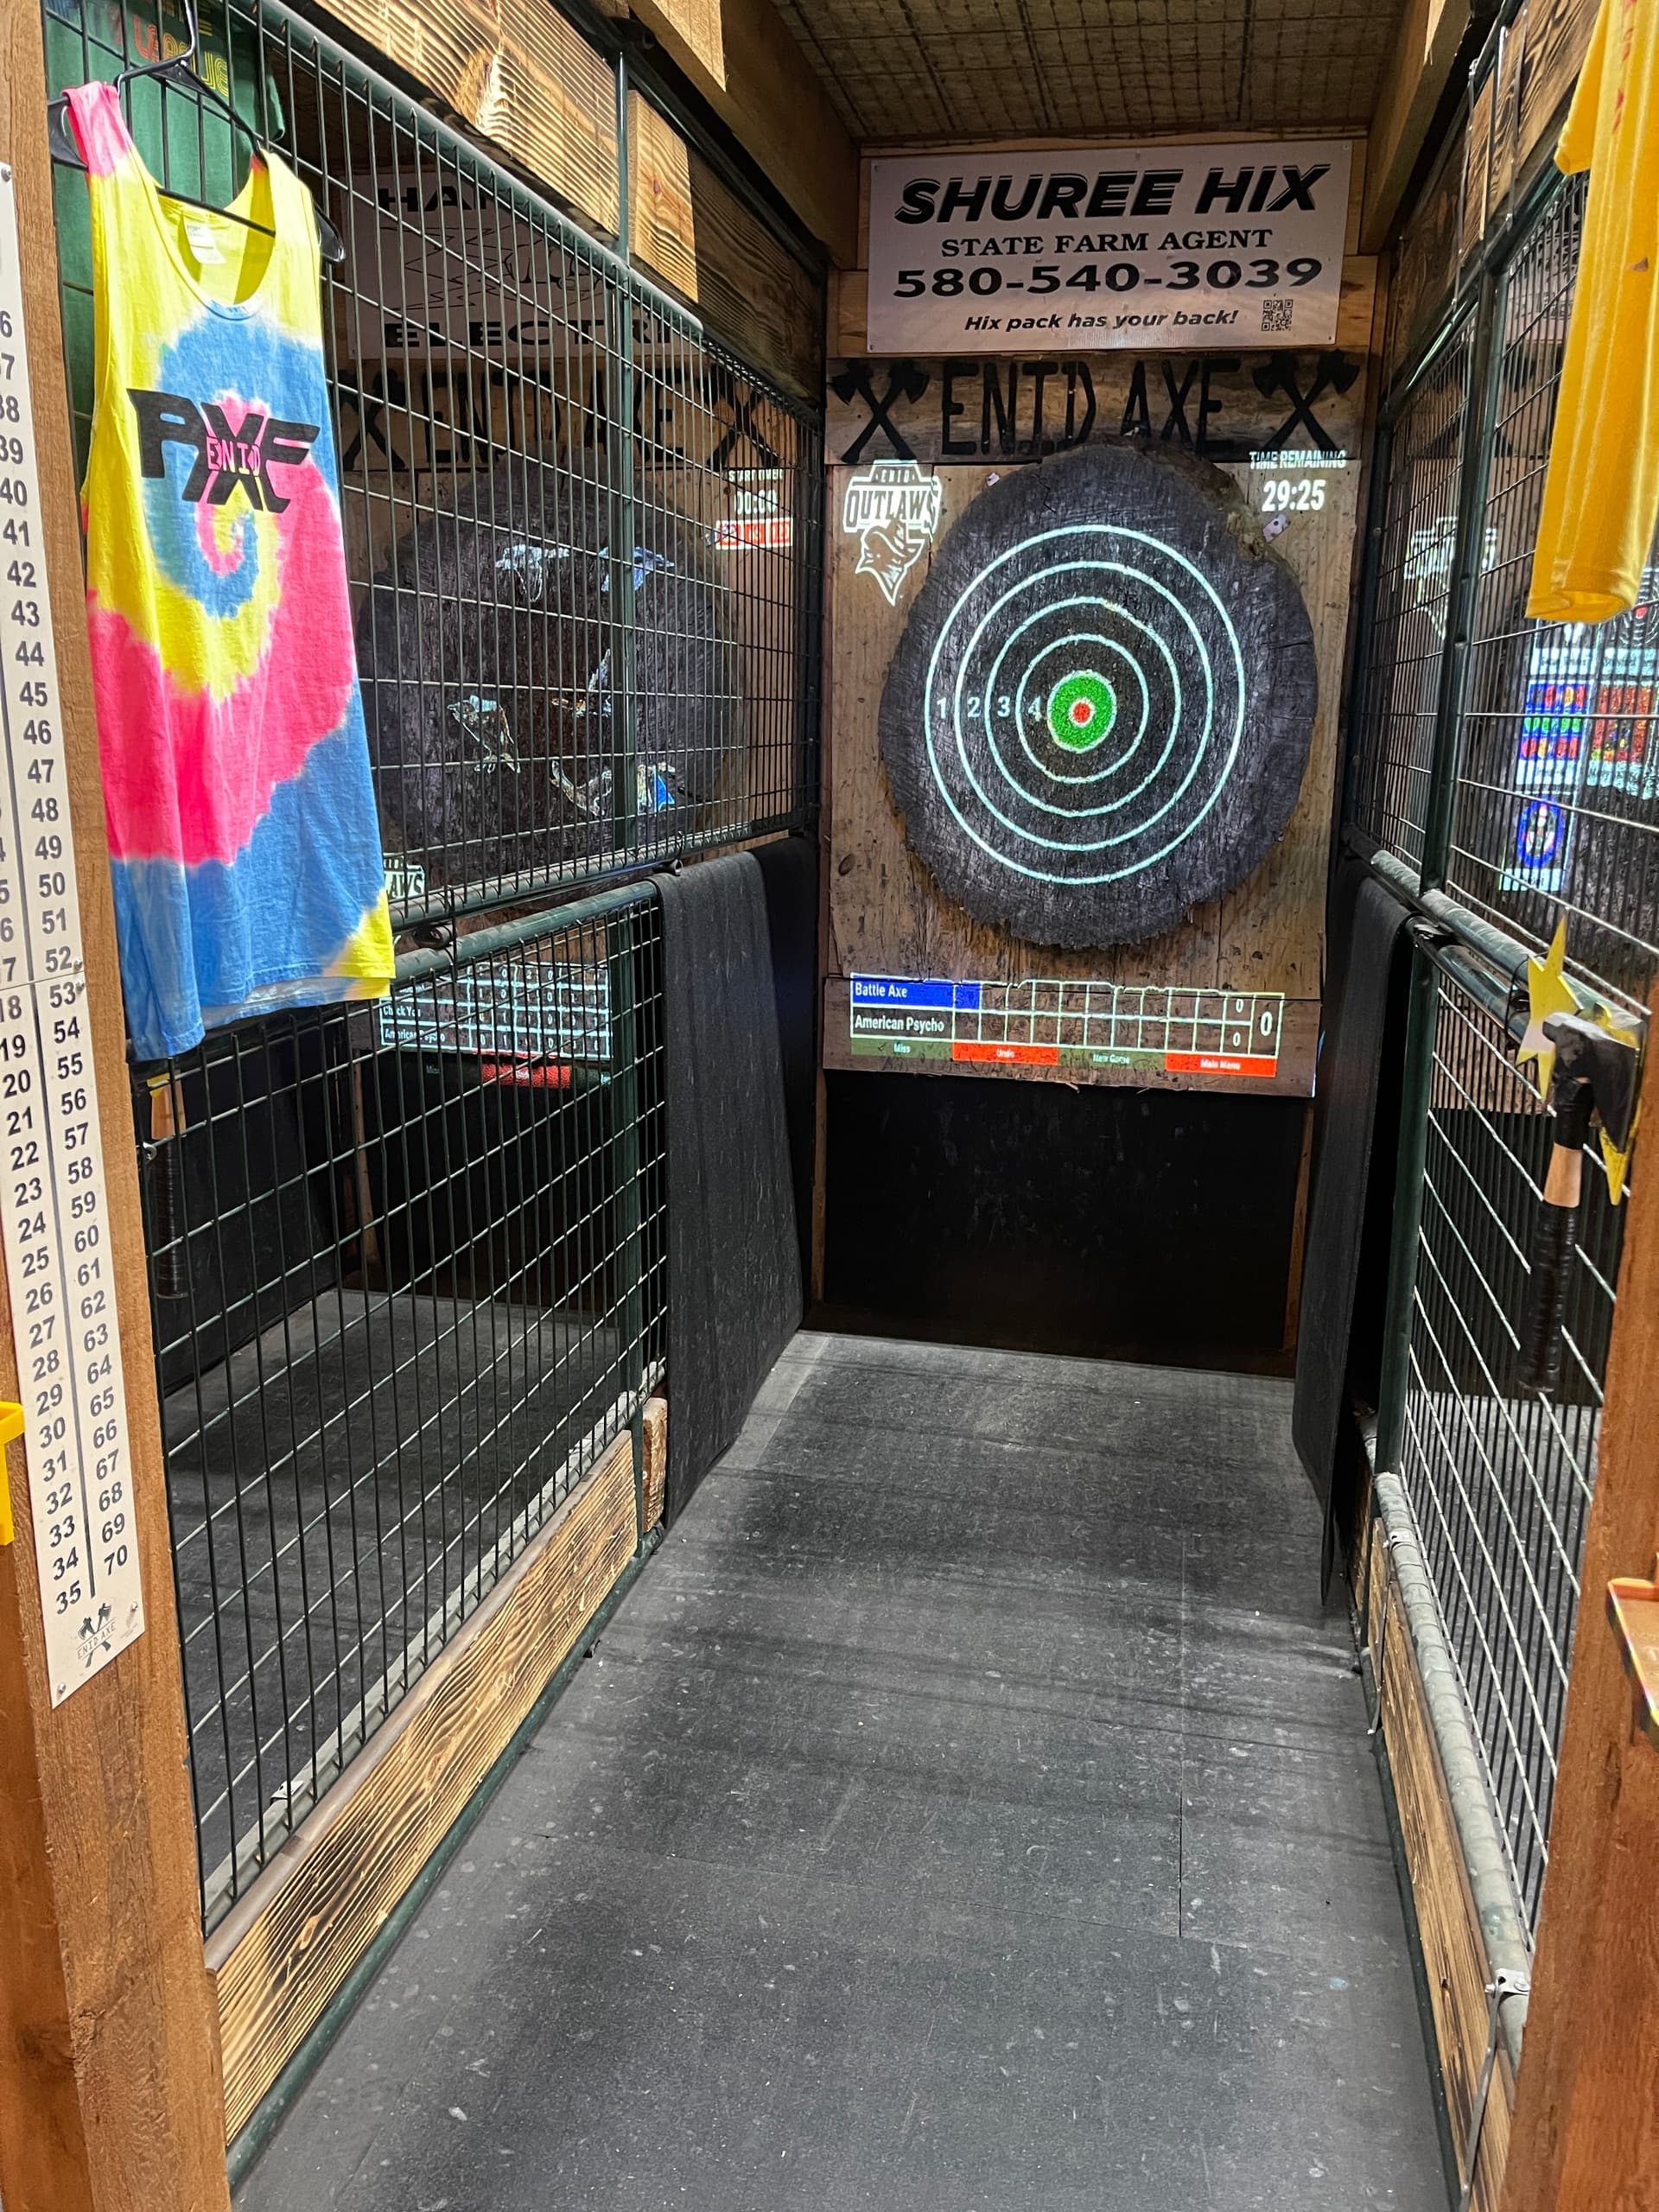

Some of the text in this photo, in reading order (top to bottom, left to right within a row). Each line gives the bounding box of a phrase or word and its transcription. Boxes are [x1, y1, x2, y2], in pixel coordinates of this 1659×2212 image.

[894, 163, 1332, 225] SHUREE HIX
[941, 228, 1274, 257] STATE FARM AGENT
[893, 257, 1323, 298] 580-540-3039
[0, 311, 12, 337] 6
[964, 308, 1239, 334] Hix pack has your back!
[0, 353, 15, 379] 7
[941, 359, 1242, 459] ENID AXE
[206, 436, 261, 475] ENID
[1249, 450, 1347, 469] TIME REMAINING
[882, 469, 910, 483] ENID
[0, 478, 27, 506] 40
[1262, 479, 1326, 512] 29:25
[846, 489, 940, 529] OUTLAWS
[3, 518, 29, 546] 41
[8, 561, 36, 588] 42
[11, 601, 39, 626] 43
[16, 641, 44, 666] 44
[20, 682, 48, 706] 45
[937, 695, 1043, 722] 1 2 3 4
[23, 720, 51, 744] 46
[28, 760, 54, 783] 47
[31, 798, 58, 822] 48
[35, 836, 61, 860] 49
[0, 880, 10, 904] 5
[40, 872, 65, 897] 50
[0, 918, 14, 942] 6
[43, 908, 67, 934] 51
[0, 957, 16, 982] 7
[47, 946, 72, 972] 52
[50, 982, 75, 1007] 53
[855, 982, 1244, 1014] Battle Axe 0
[383, 1004, 406, 1017] Chck
[1260, 1011, 1274, 1037] 0
[54, 1016, 79, 1044] 54
[855, 1014, 1241, 1047] American Psycho 0
[0, 1034, 25, 1061] 19
[893, 1043, 912, 1054] Miss
[996, 1048, 1015, 1059] Undo
[1200, 1058, 1218, 1069] Main
[58, 1052, 82, 1079] 55
[3, 1070, 31, 1098] 20
[61, 1088, 86, 1115] 56
[7, 1106, 33, 1136] 21
[65, 1122, 88, 1149] 57
[10, 1141, 39, 1171] 22
[68, 1157, 92, 1184] 58
[15, 1178, 42, 1207] 23
[72, 1192, 95, 1218] 59
[18, 1211, 46, 1243] 24
[75, 1225, 99, 1252] 60
[22, 1246, 49, 1277] 25
[79, 1258, 100, 1286] 61
[26, 1282, 53, 1313] 26
[81, 1291, 105, 1319] 62
[30, 1316, 55, 1348] 27
[85, 1324, 108, 1351] 63
[34, 1350, 60, 1382] 28
[88, 1355, 111, 1383] 64
[37, 1384, 62, 1415] 29
[91, 1387, 114, 1416] 65
[40, 1417, 66, 1447] 30
[94, 1419, 117, 1448] 66
[43, 1451, 67, 1482] 31
[97, 1449, 119, 1479] 67
[47, 1483, 73, 1514] 32
[99, 1482, 122, 1511] 68
[50, 1516, 75, 1547] 33
[102, 1514, 125, 1542] 69
[54, 1547, 79, 1580] 34
[105, 1545, 127, 1575] 70
[57, 1580, 81, 1614] 35
